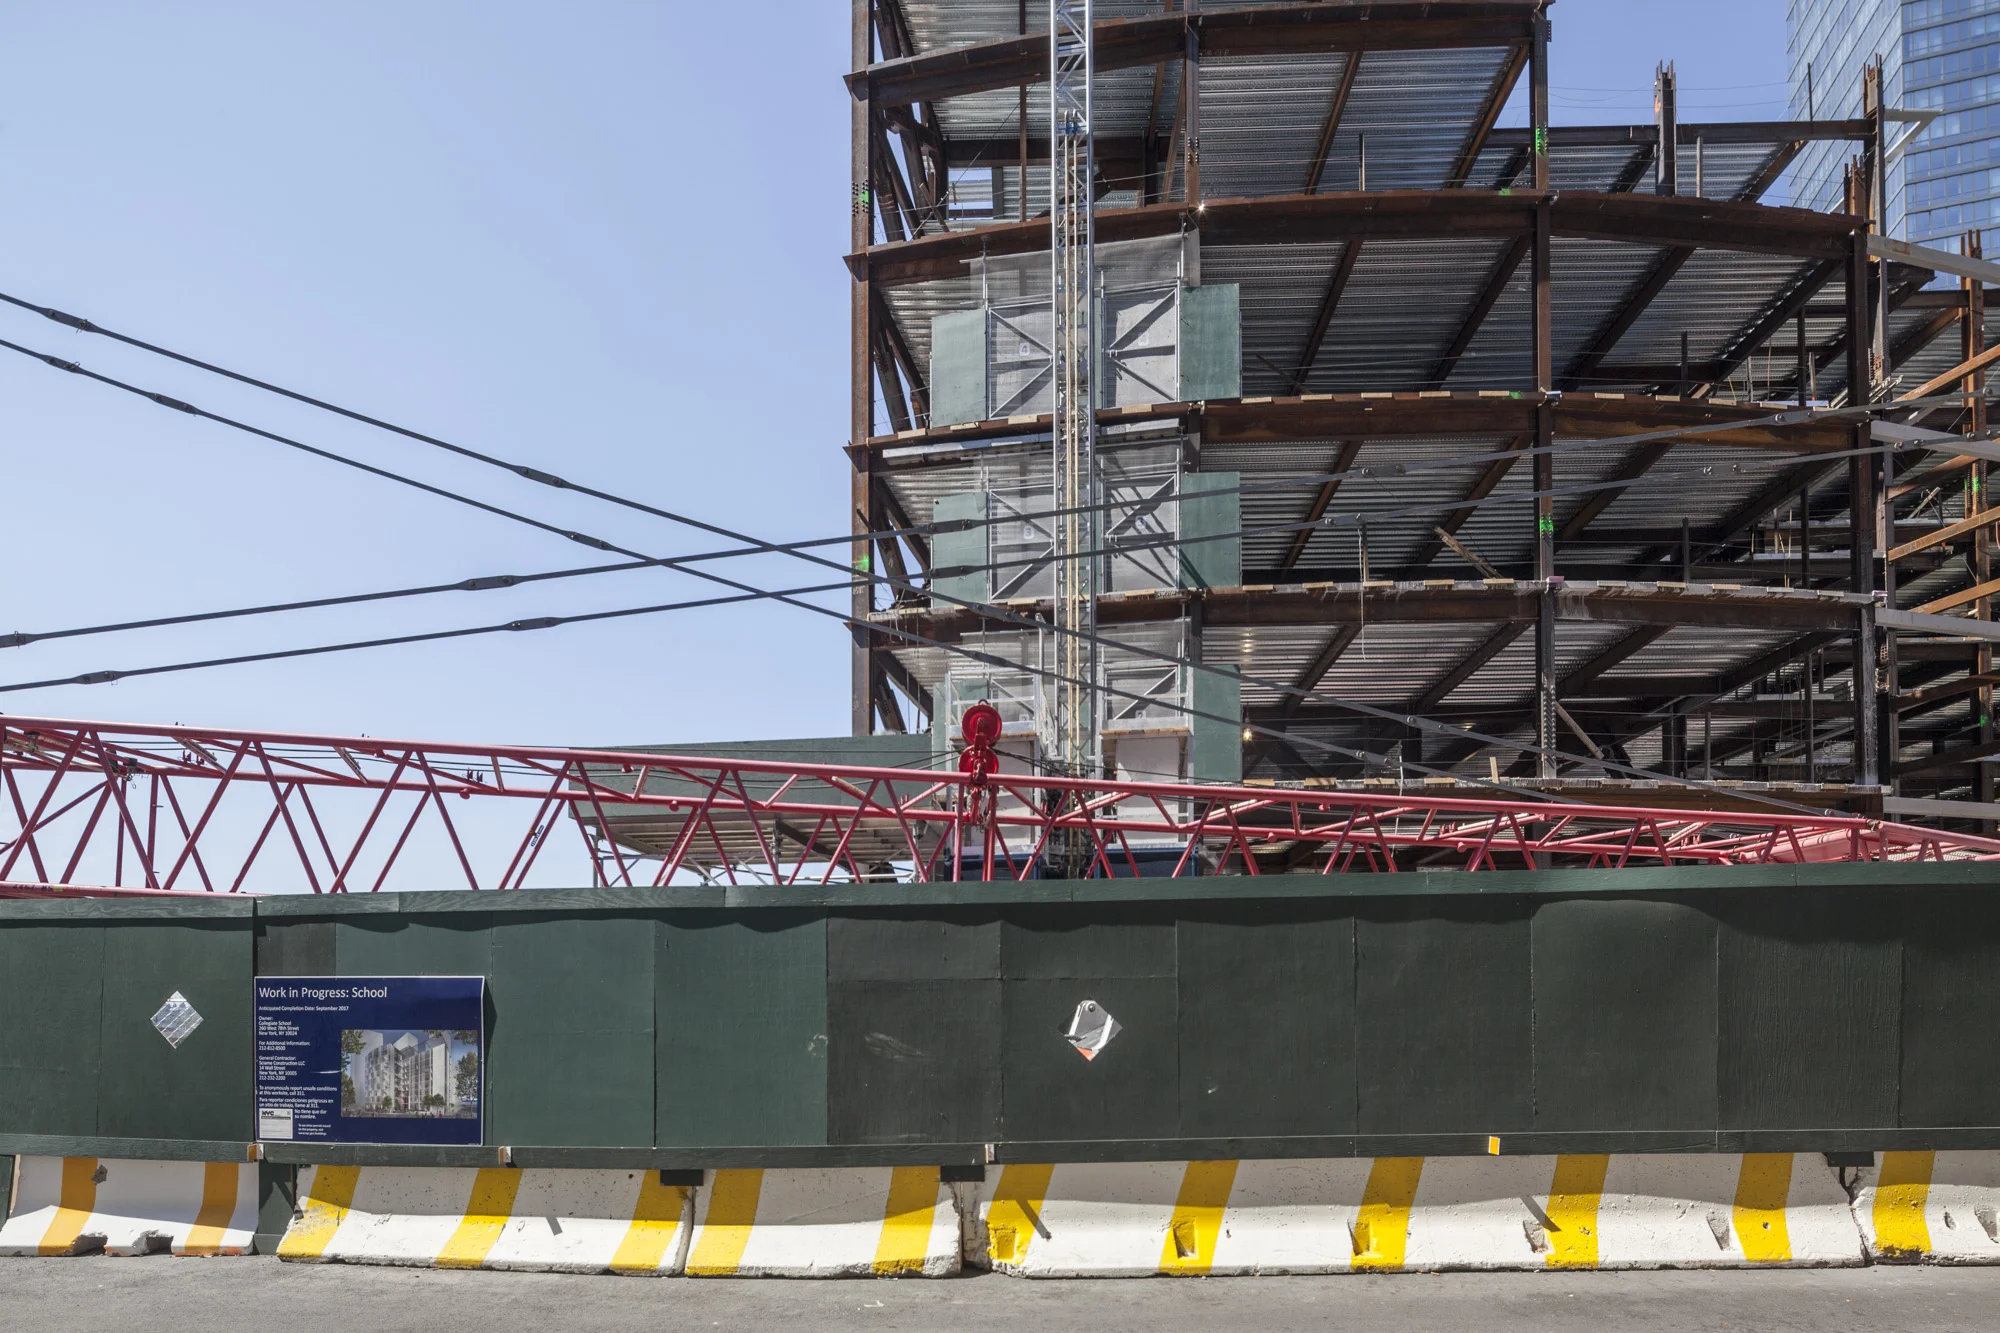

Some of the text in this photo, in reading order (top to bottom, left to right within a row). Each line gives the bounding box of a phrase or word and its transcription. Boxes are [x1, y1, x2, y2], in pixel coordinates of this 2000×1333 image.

[259, 986, 387, 1000] Work in Progress: School
